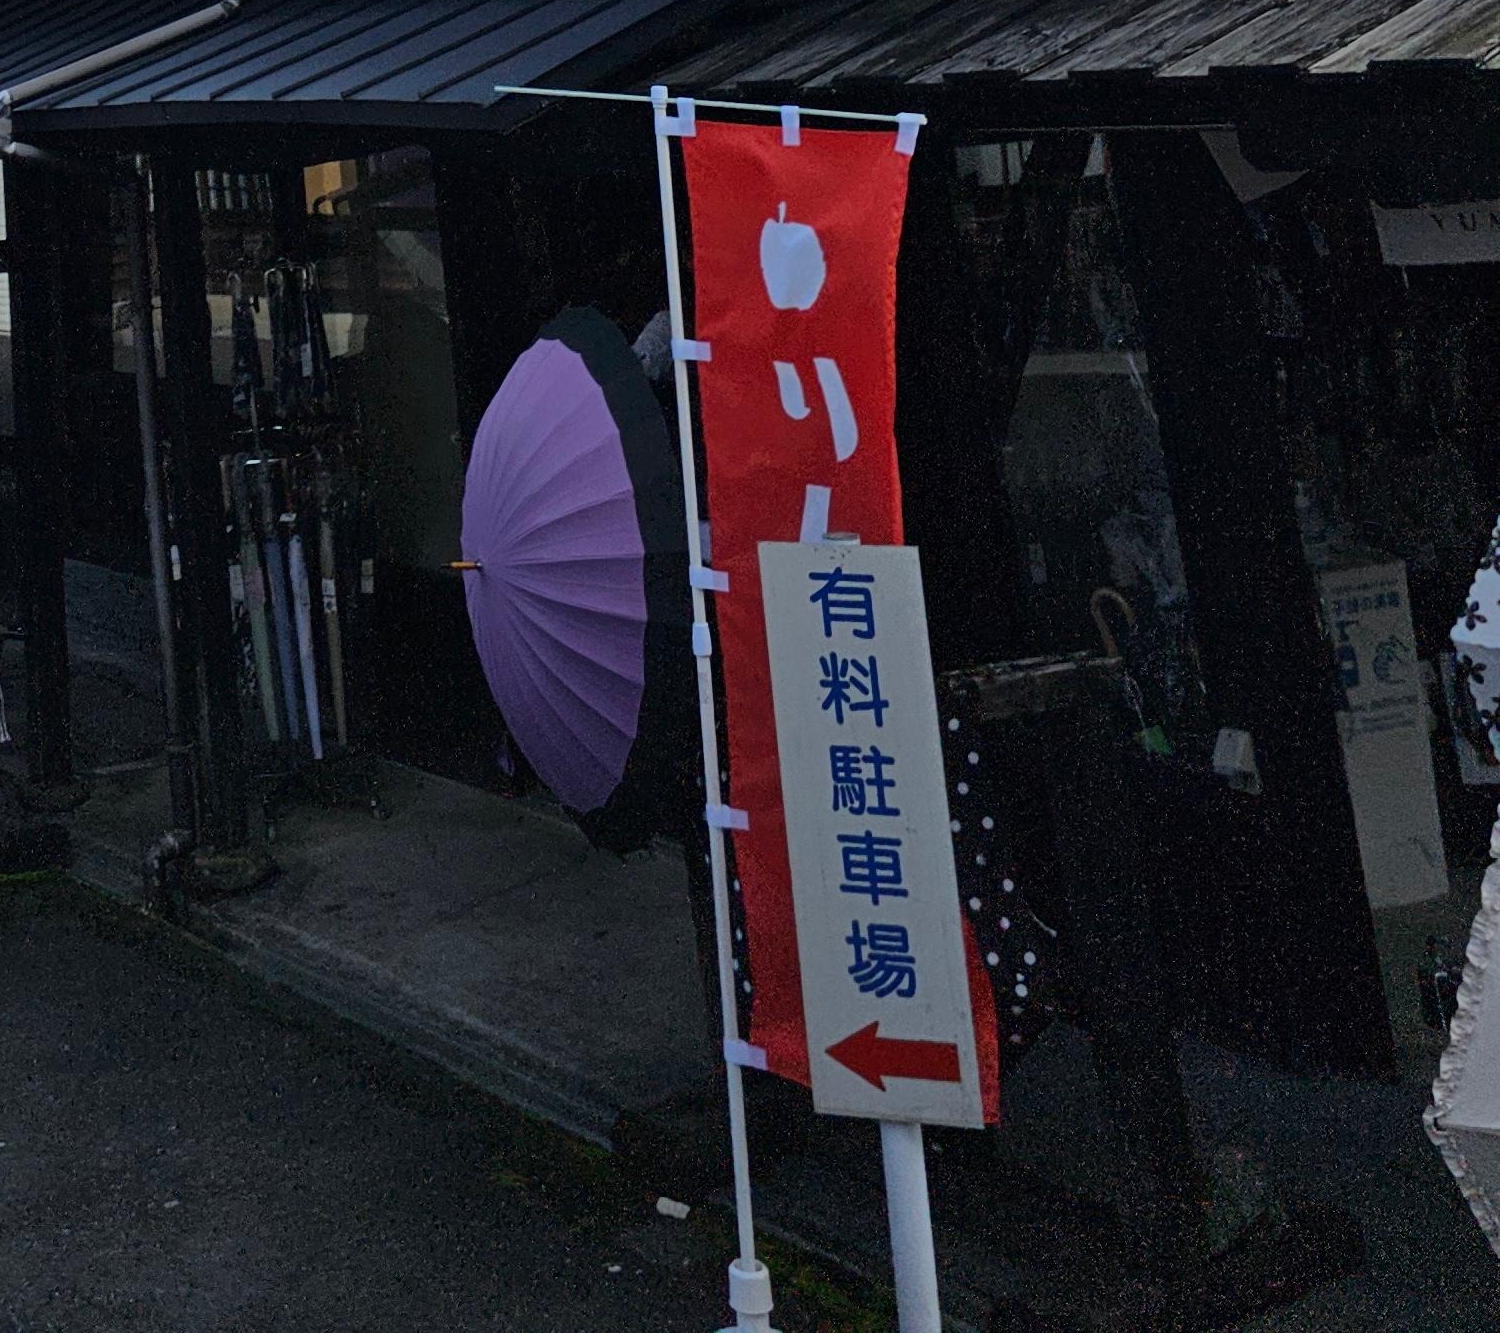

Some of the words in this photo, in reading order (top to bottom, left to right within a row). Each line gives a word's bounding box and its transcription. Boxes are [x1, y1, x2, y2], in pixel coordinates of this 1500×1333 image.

[808, 566, 917, 999] 有料駐車場
